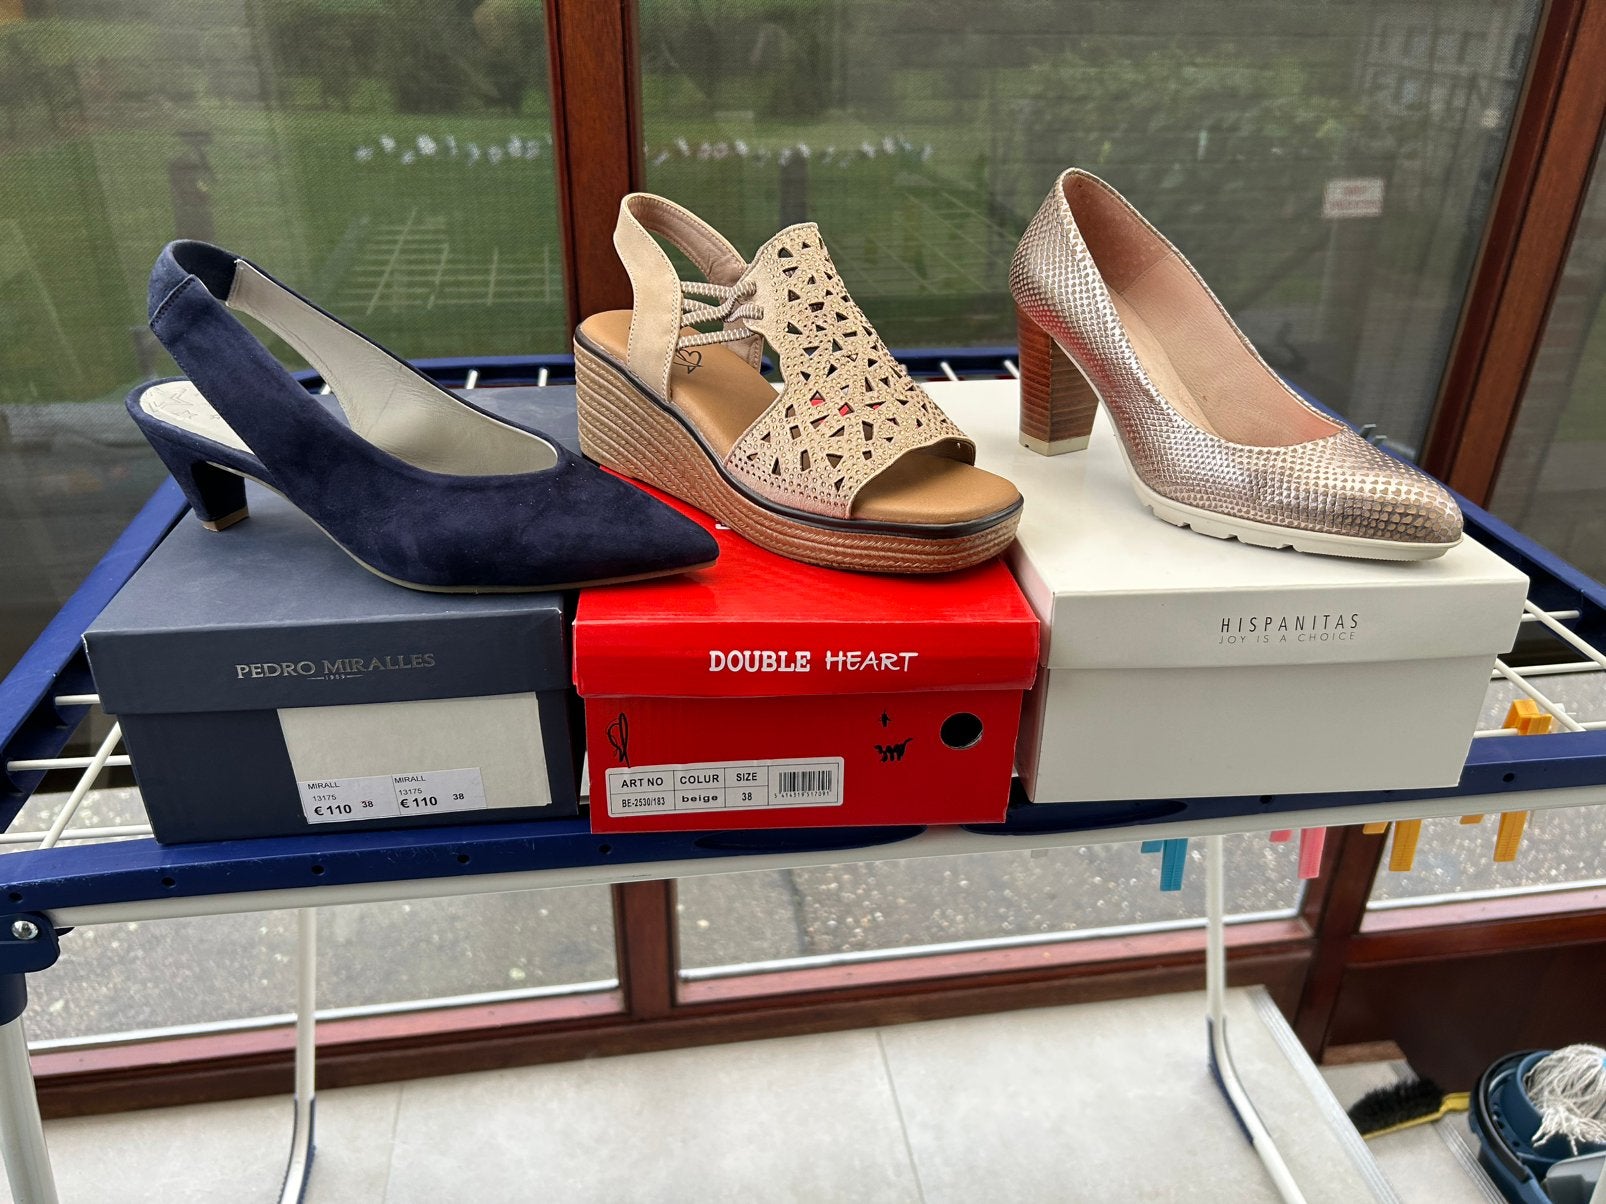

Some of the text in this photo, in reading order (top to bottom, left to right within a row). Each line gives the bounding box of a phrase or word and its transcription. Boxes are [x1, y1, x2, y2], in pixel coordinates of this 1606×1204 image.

[1220, 613, 1359, 633] HISPANITAS
[1219, 632, 1356, 645] JOY IS A CHOICE
[709, 650, 919, 672] DOUBLE HEART
[235, 653, 436, 679] PEDRO MIRALLES
[394, 775, 427, 784] MIRALL
[679, 774, 720, 785] COLUR
[736, 772, 758, 782] SIZE
[307, 782, 341, 790] MIRALL
[621, 777, 664, 788] ART NO
[398, 788, 423, 796] 13175
[741, 792, 753, 801] 38
[312, 794, 337, 802] 13175
[452, 793, 465, 801] 38
[681, 794, 719, 803] beige
[361, 800, 374, 808] 38
[621, 797, 666, 808] BE-2530/183
